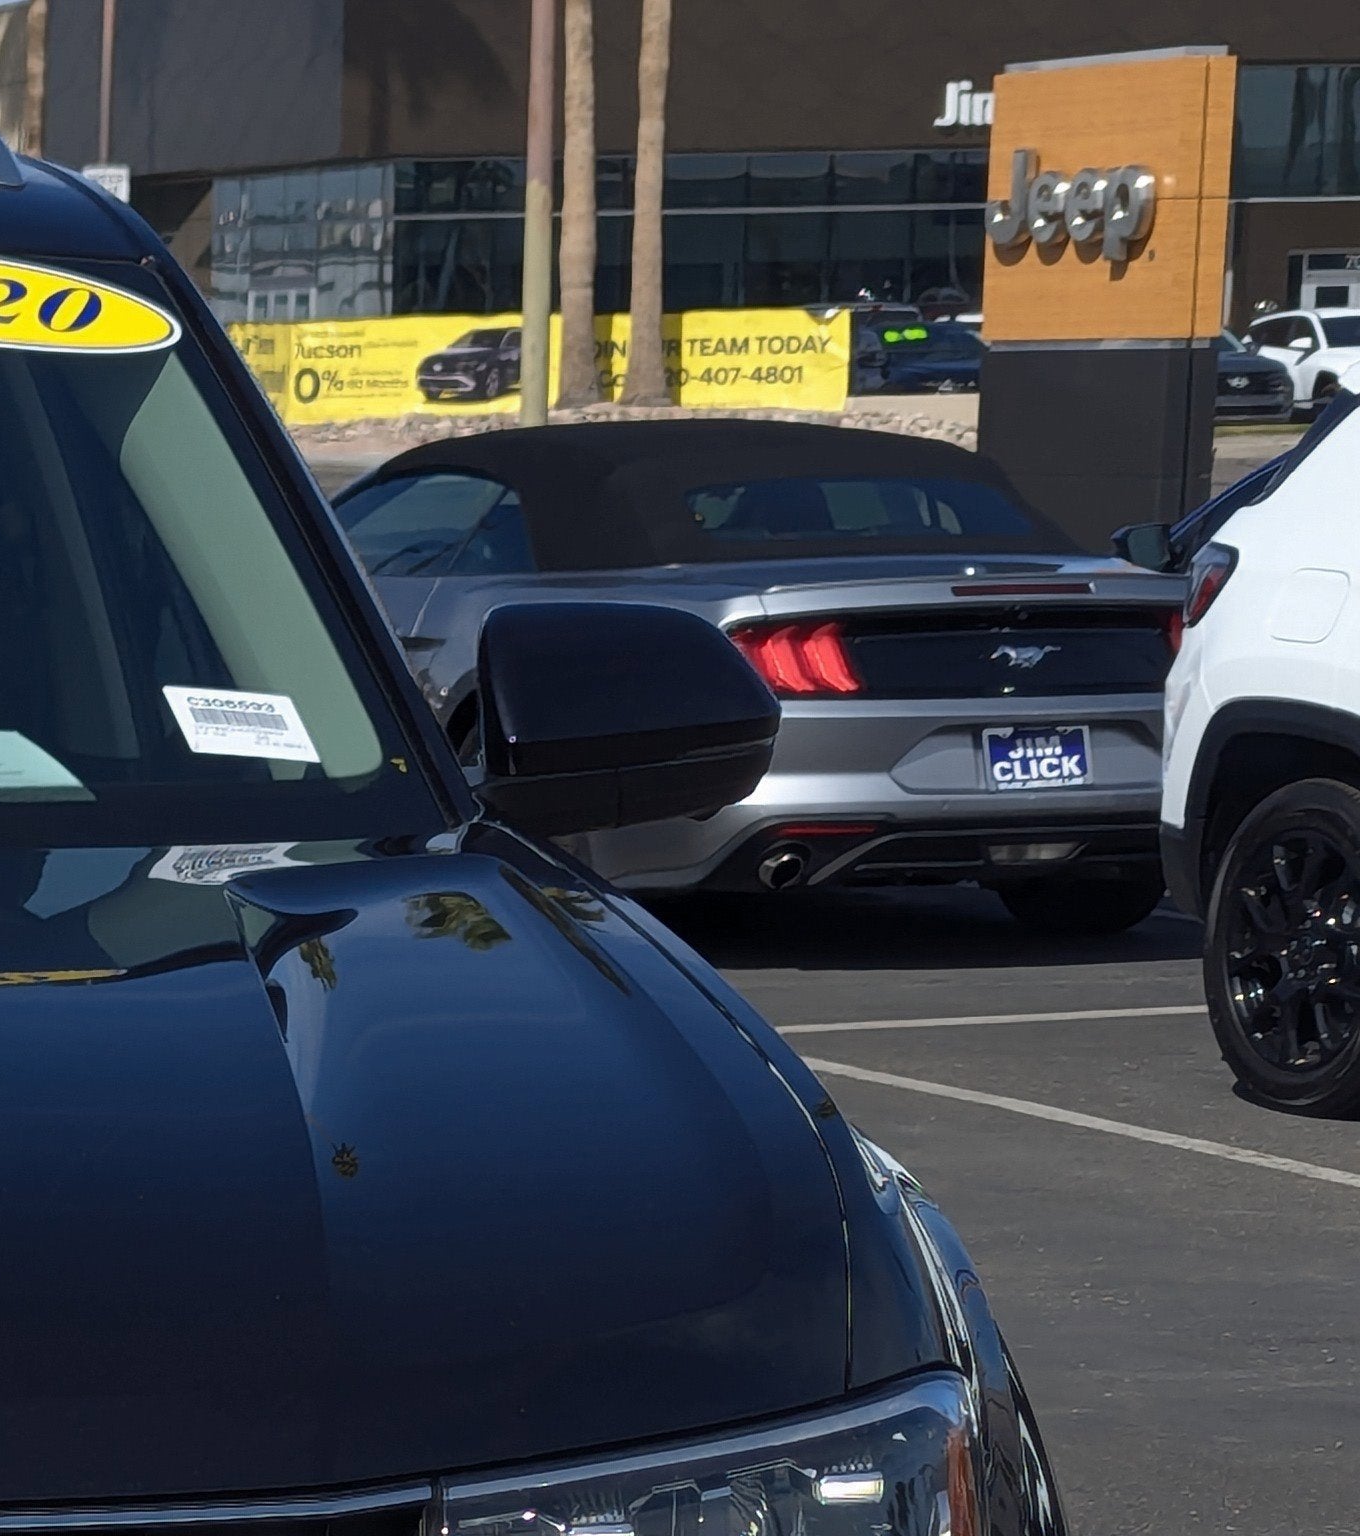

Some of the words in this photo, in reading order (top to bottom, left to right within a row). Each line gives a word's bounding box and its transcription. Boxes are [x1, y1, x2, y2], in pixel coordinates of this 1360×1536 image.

[985, 149, 1156, 262] Jeep
[687, 337, 750, 357] TEAM
[755, 335, 832, 356] TODAY
[665, 365, 803, 387] 20-407-4801
[1008, 735, 1063, 759] JIM
[992, 754, 1082, 782] CLICK
